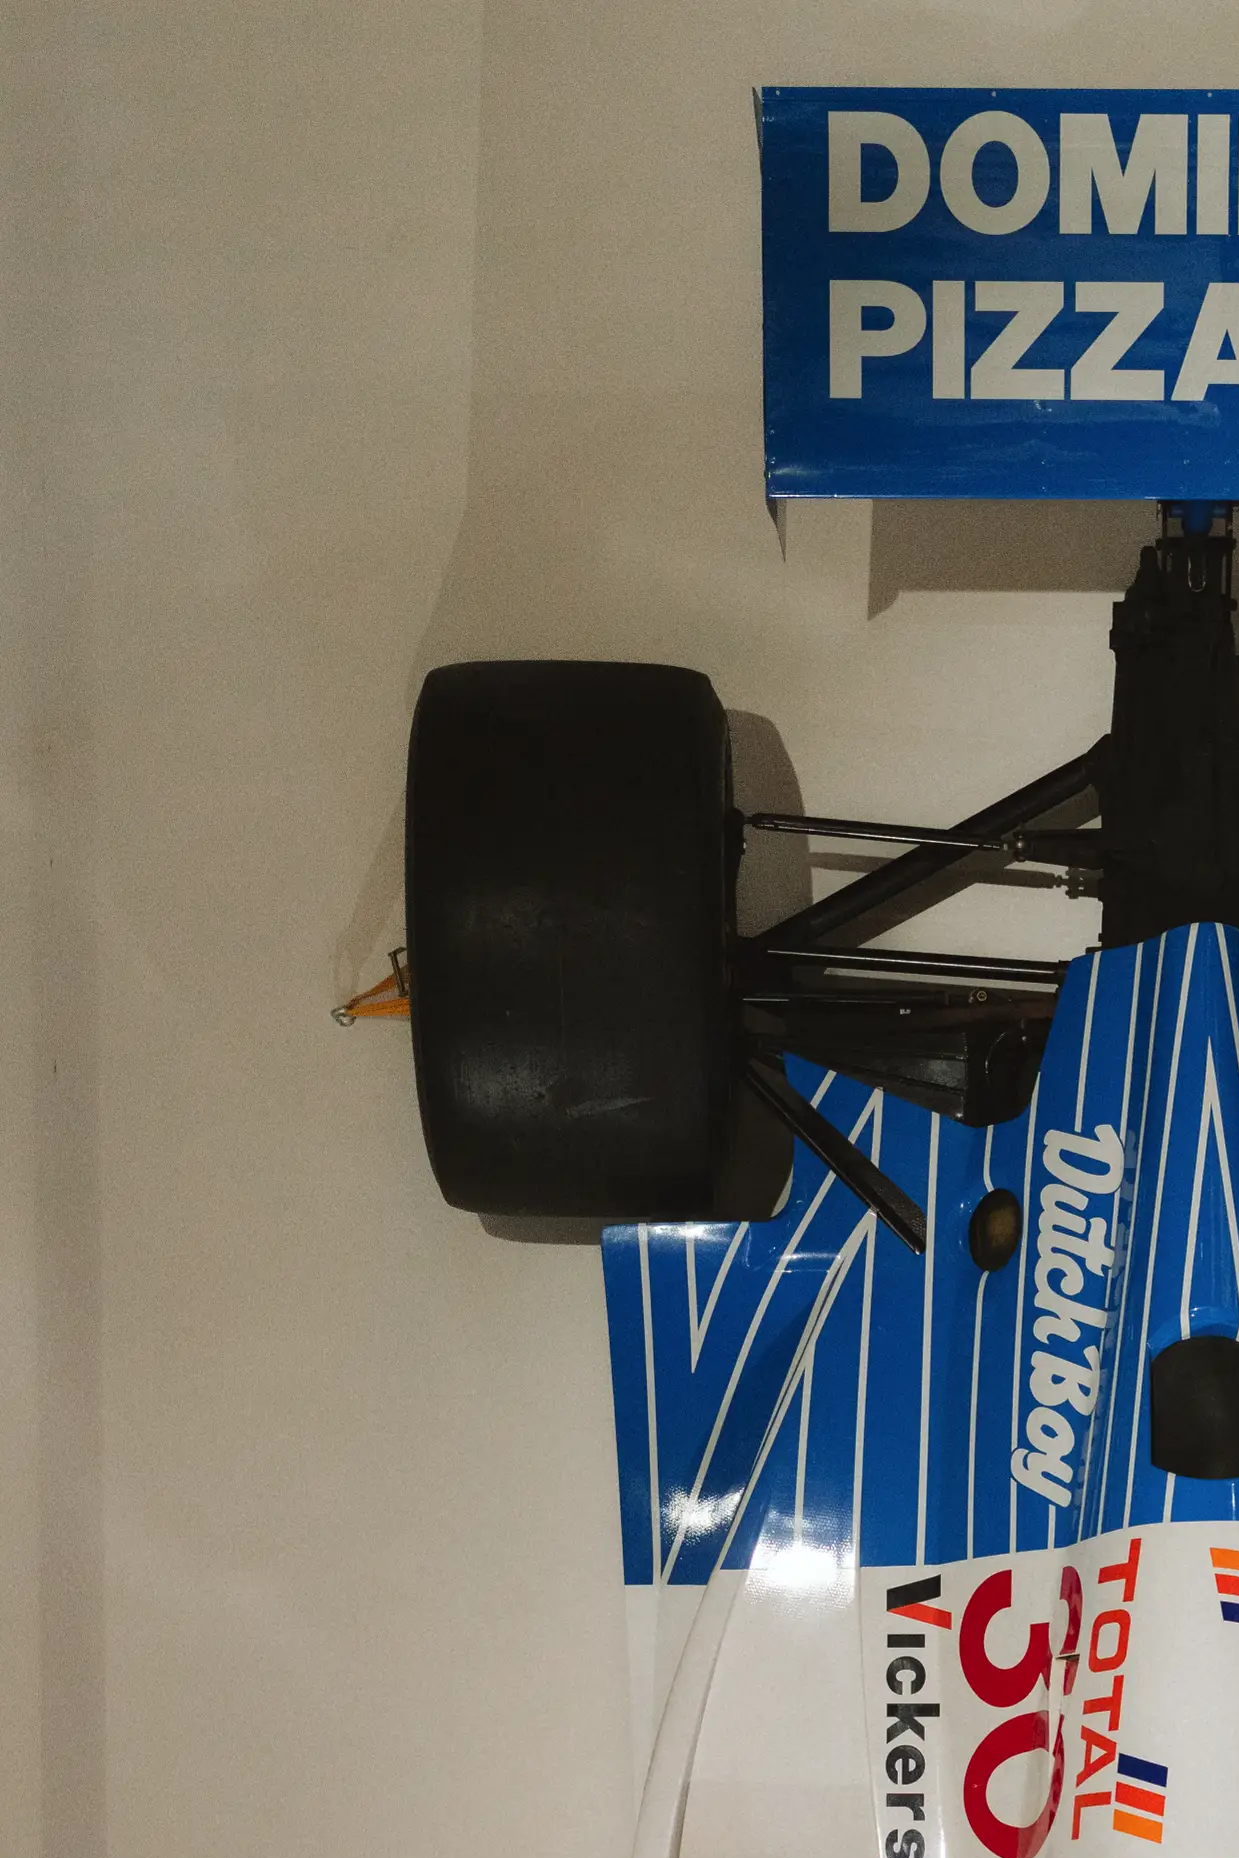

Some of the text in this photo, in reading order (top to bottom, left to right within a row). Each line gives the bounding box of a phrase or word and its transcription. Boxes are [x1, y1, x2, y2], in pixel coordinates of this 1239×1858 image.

[1011, 1123, 1124, 1508] Dutch Boy
[1071, 1538, 1141, 1841] TOTAL
